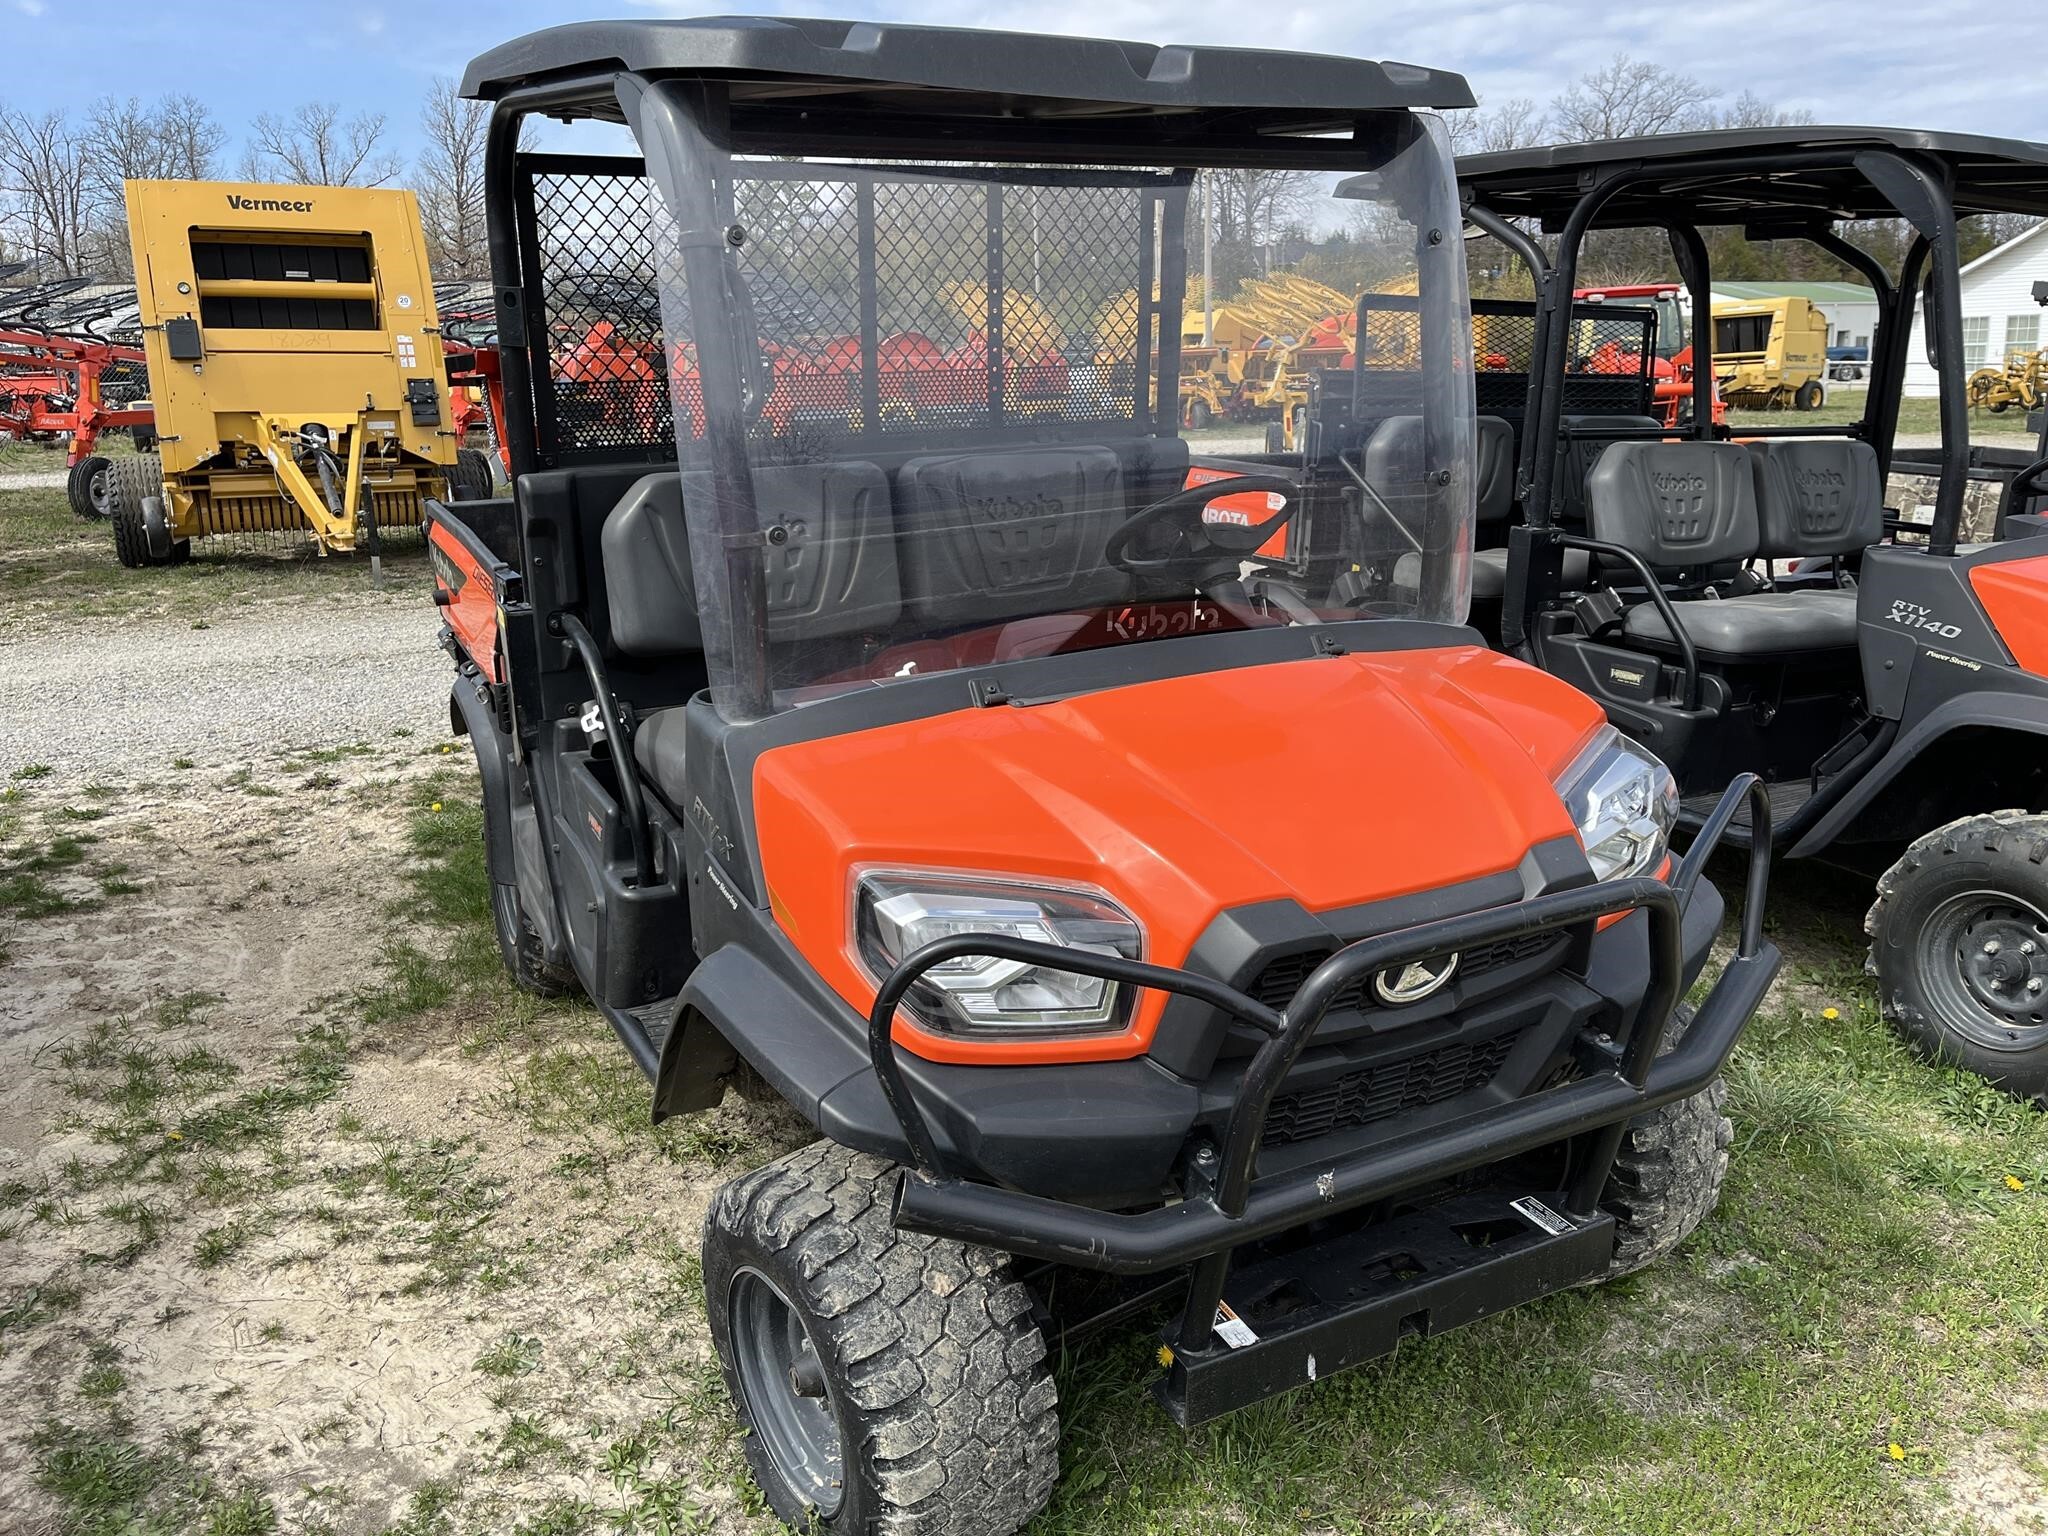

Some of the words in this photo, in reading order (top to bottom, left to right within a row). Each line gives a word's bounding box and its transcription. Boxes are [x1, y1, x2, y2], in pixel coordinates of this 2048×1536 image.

[226, 194, 313, 213] Vermeer
[1106, 599, 1221, 639] Kubota
[1892, 599, 1932, 616] RTV
[1884, 608, 1962, 639] X1140
[1926, 650, 1950, 662] Power
[1949, 656, 1983, 672] Steering
[707, 865, 721, 885] Power
[719, 882, 738, 910] Steering
